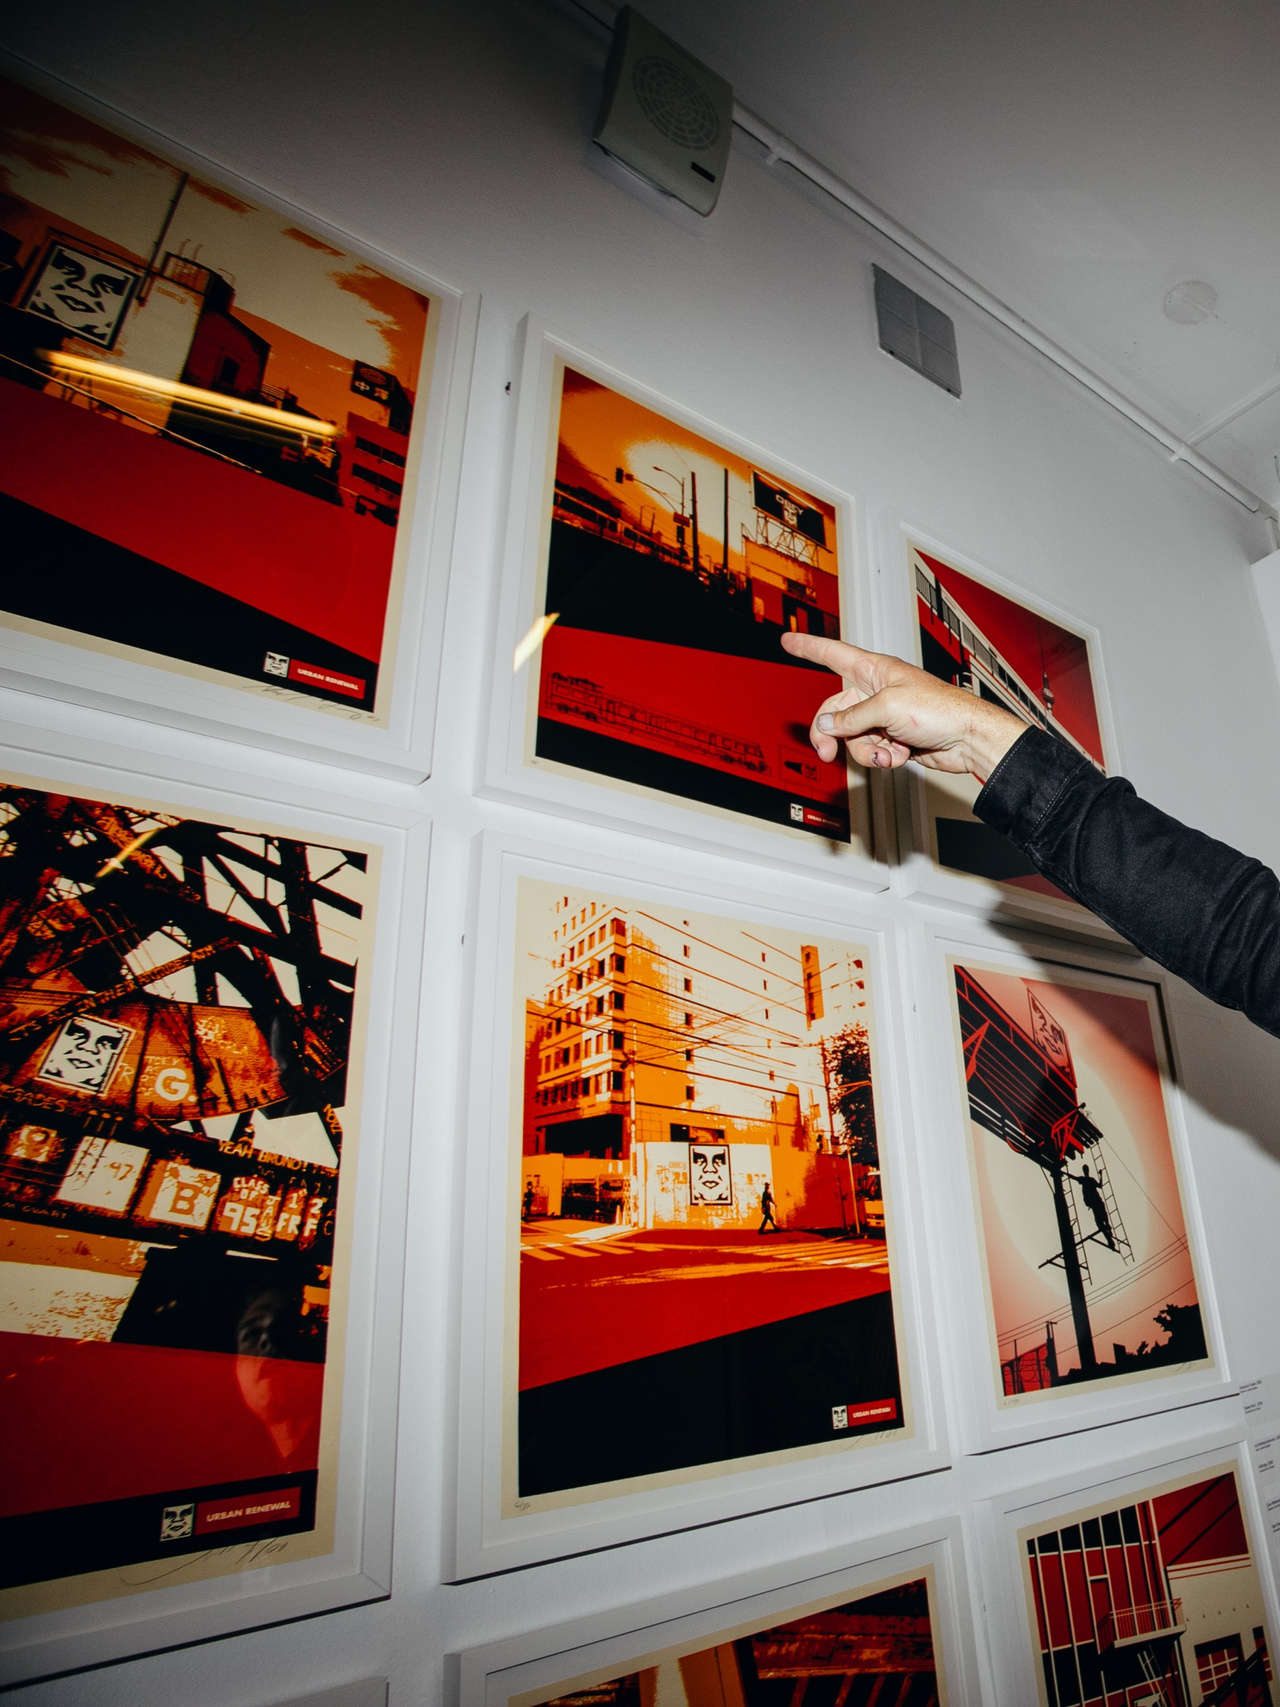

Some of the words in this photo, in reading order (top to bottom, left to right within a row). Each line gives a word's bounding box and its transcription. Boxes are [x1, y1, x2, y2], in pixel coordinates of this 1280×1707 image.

[297, 668, 324, 681] URBAN
[325, 676, 359, 691] RENEWAL
[218, 1140, 254, 1159] YEAH
[233, 1176, 271, 1195] CLASS
[240, 1188, 260, 1202] OF
[222, 1201, 262, 1235] 95
[206, 1508, 244, 1523] URBAN
[245, 1500, 292, 1516] RENEWAL
